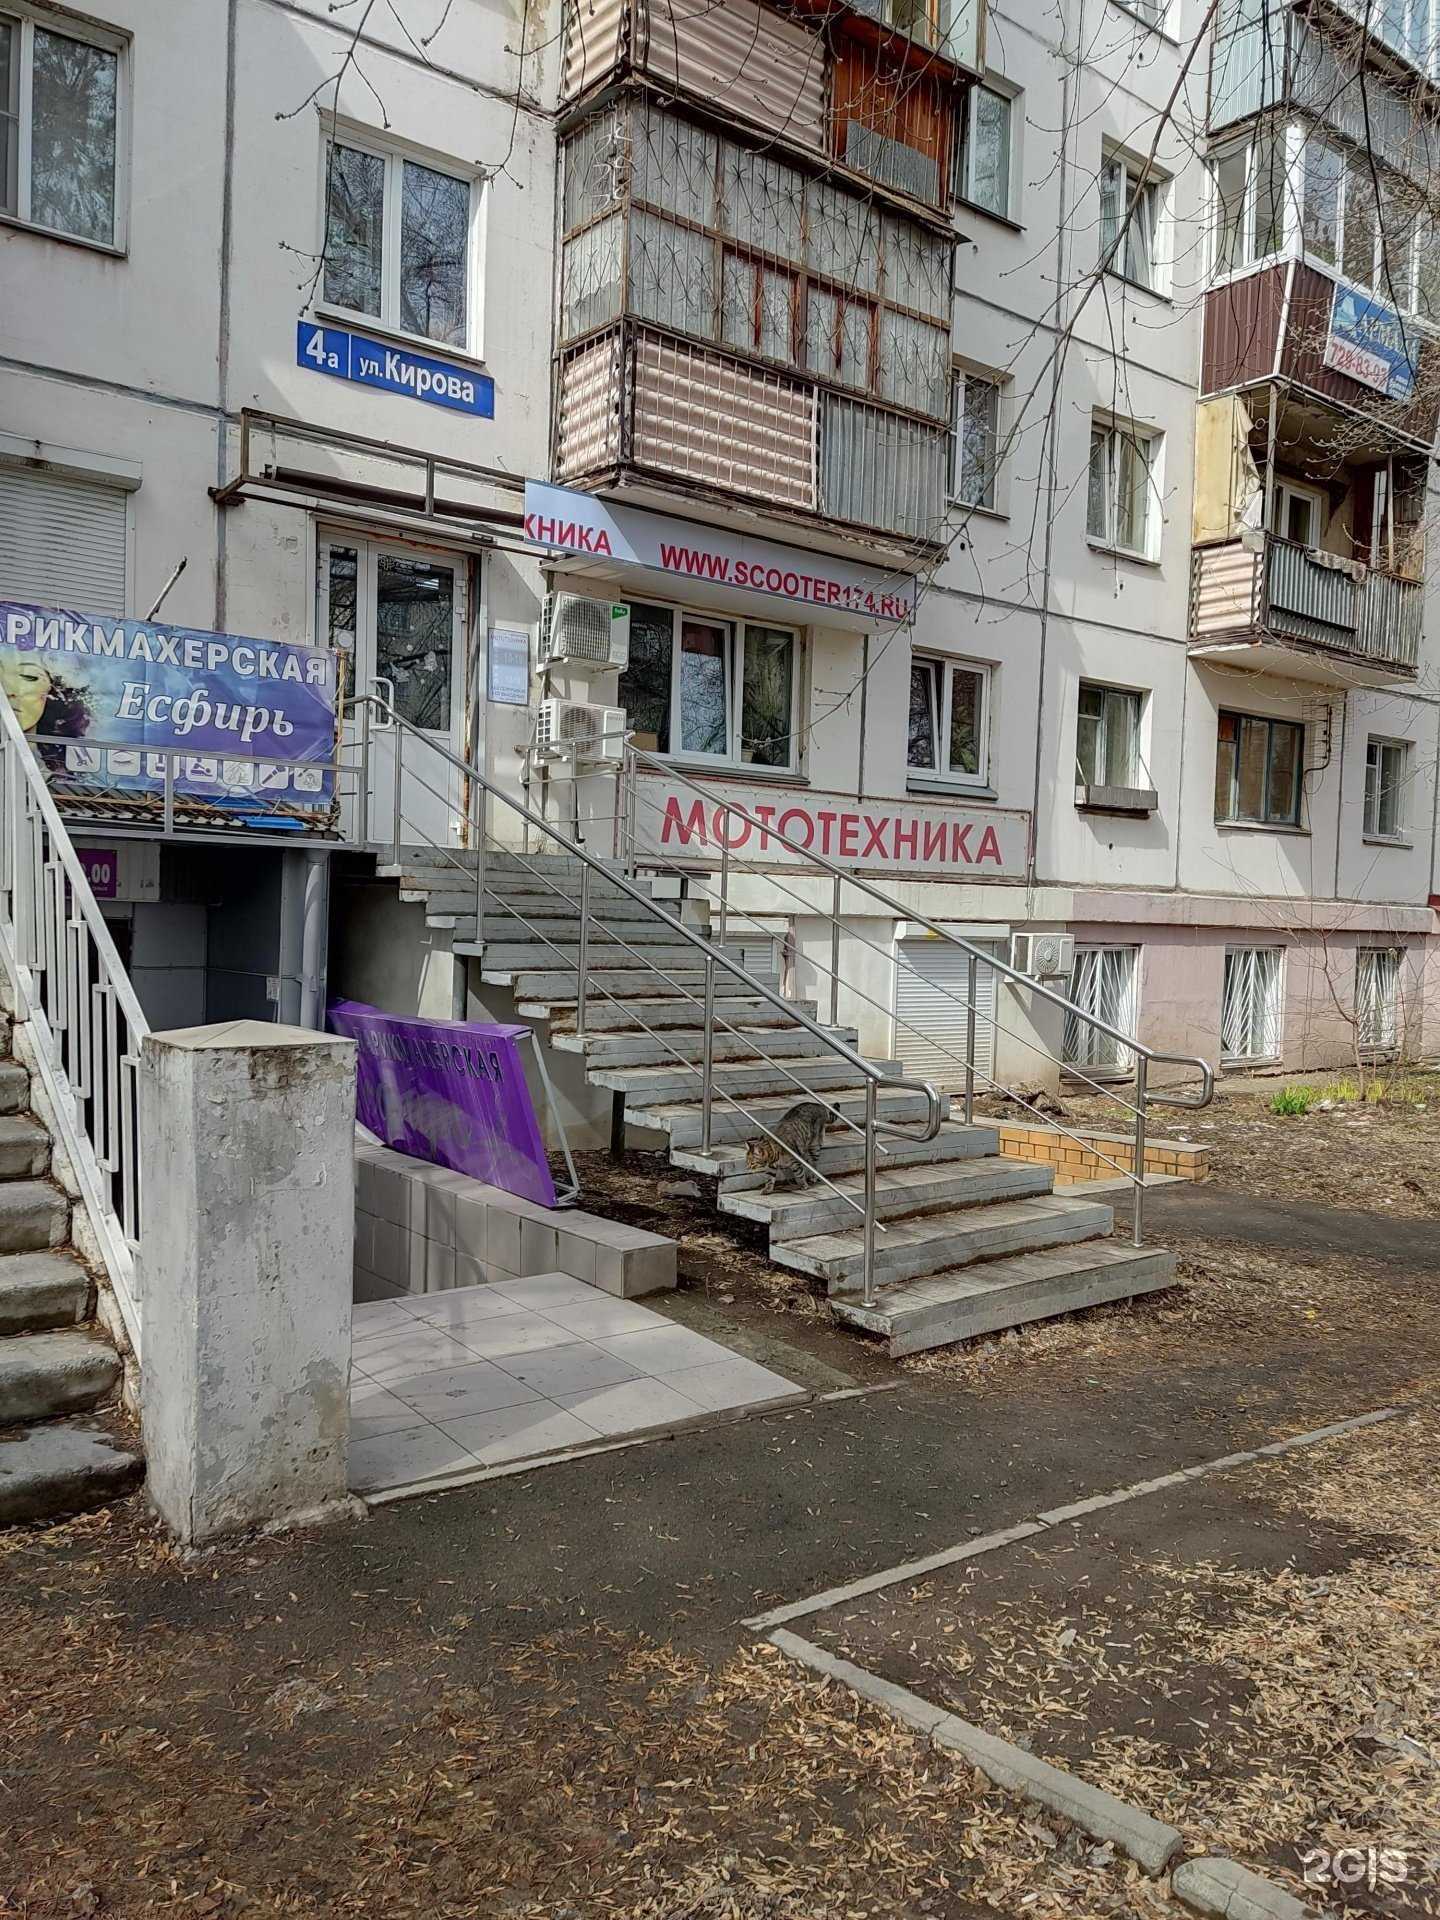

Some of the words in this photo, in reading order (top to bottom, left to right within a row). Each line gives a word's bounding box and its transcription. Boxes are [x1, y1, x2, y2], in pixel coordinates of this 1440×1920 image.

[306, 329, 339, 369] 4а
[0, 612, 327, 686] РИКМАХЕРСКАЯ
[115, 680, 295, 742] Есфирь
[660, 796, 1003, 866] МОТОТЕХНИКА
